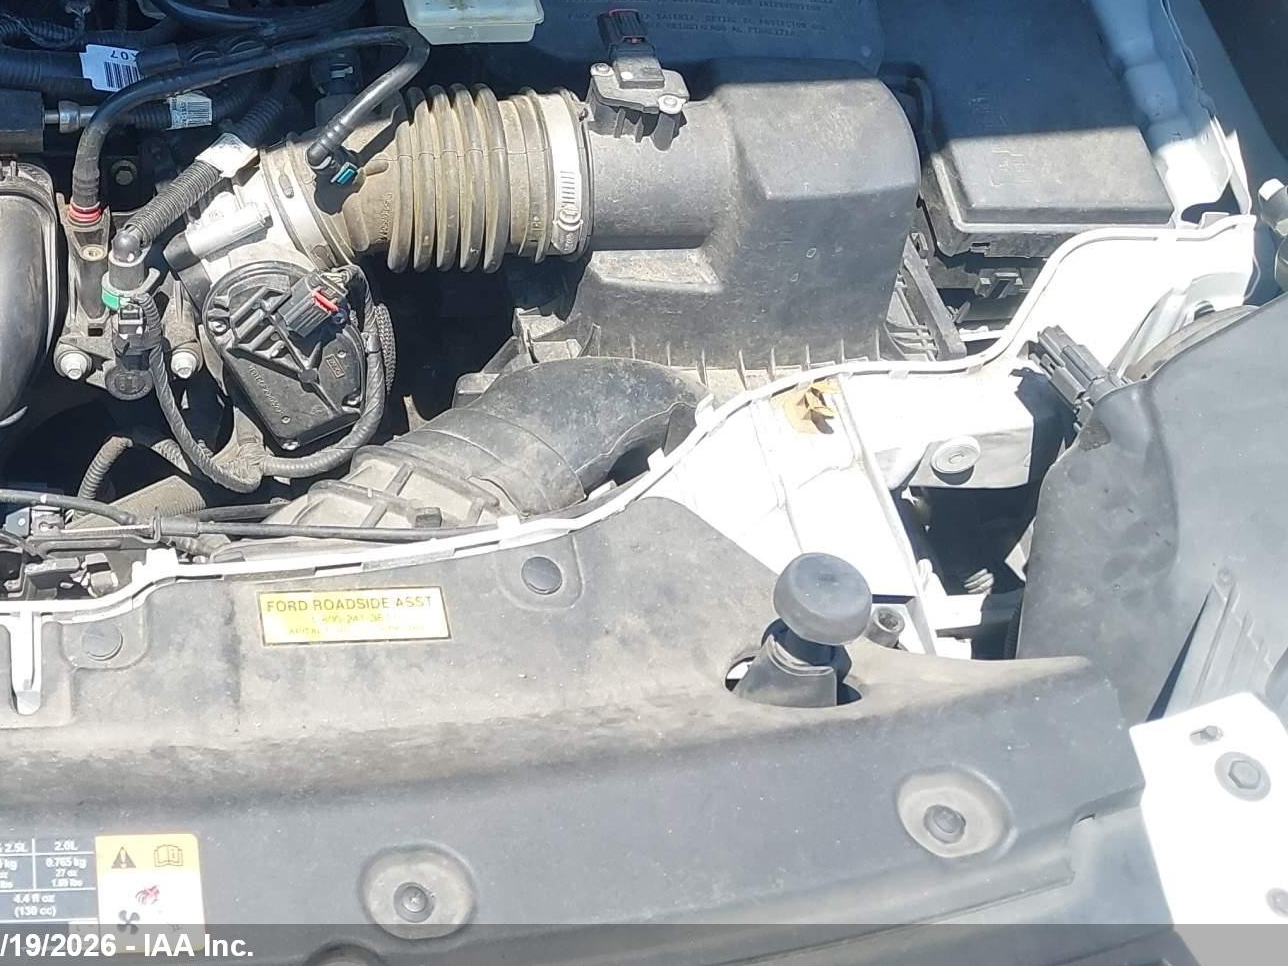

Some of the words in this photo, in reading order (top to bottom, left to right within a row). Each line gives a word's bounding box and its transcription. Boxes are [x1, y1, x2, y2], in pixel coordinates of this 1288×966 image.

[267, 600, 308, 612] FORD
[314, 597, 390, 611] ROADSIDE
[396, 596, 432, 608] ASST
[4, 842, 28, 852] 2.5L
[54, 840, 78, 851] 2.0L
[4, 859, 18, 871] kg
[74, 858, 86, 869] kg
[13, 894, 30, 904] 4.4
[14, 906, 38, 918] (130
[39, 905, 56, 918] cc)
